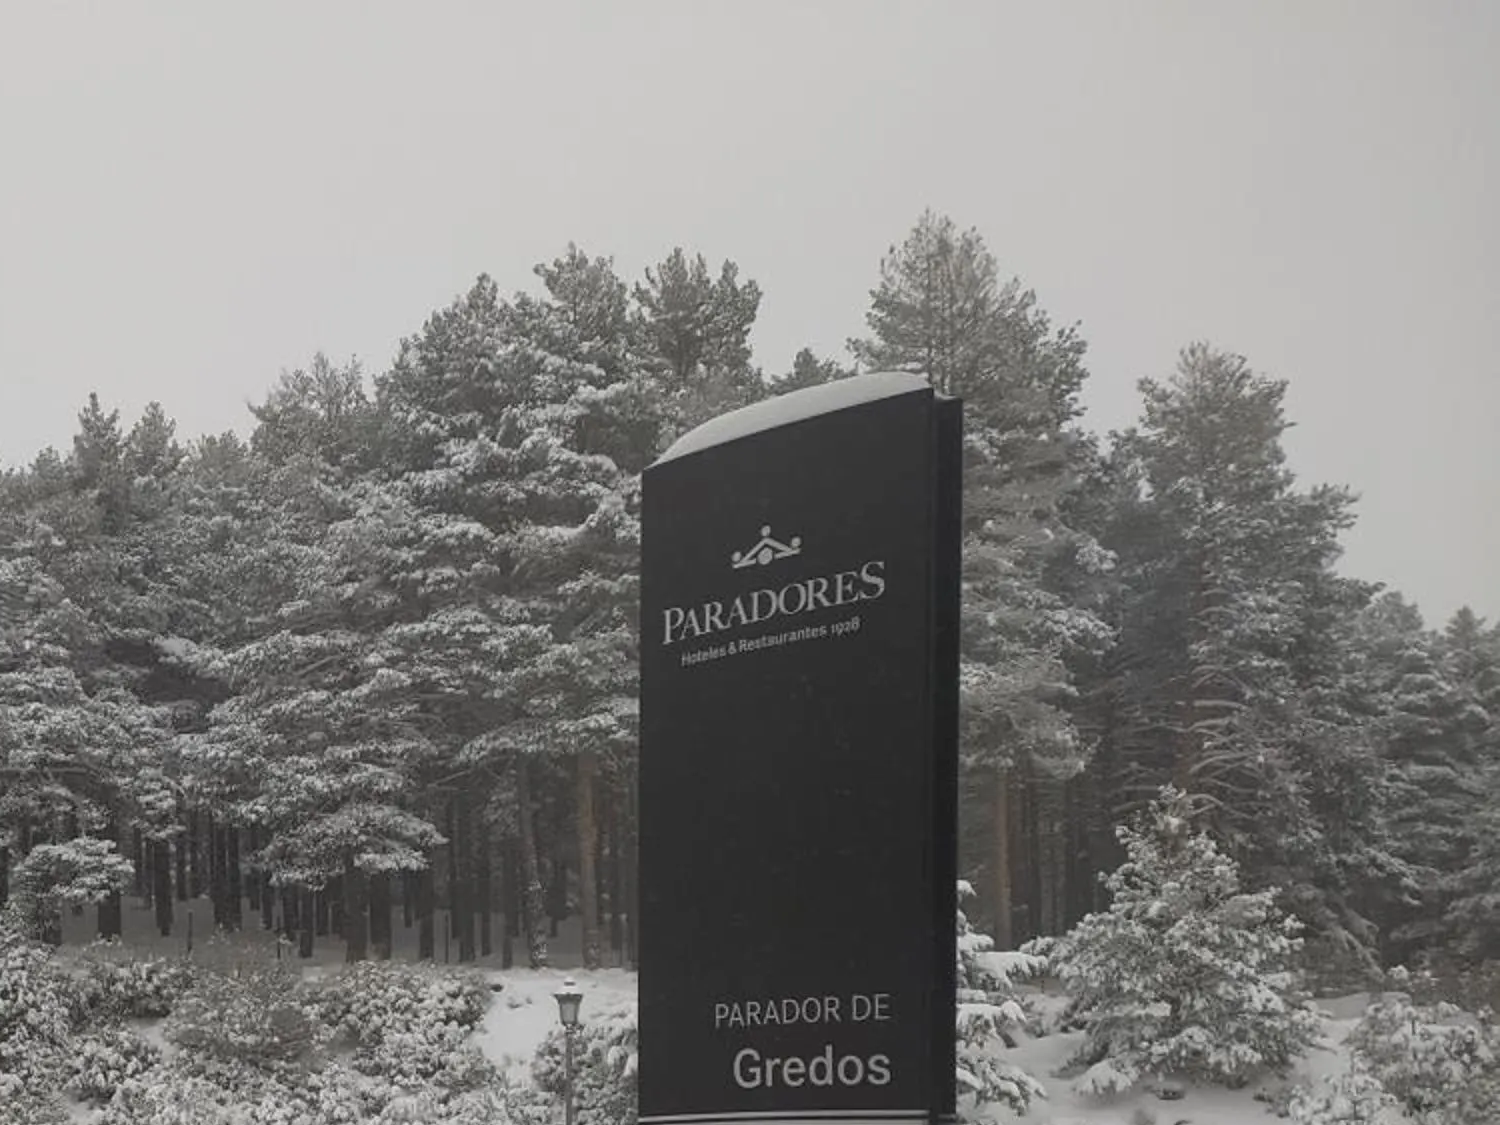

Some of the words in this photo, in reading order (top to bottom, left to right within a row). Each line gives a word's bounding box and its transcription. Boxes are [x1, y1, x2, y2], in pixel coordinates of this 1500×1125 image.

[662, 561, 885, 644] PARADORES
[681, 642, 727, 667] Hoteles
[728, 639, 737, 655] &
[739, 625, 827, 653] Restaurantes
[831, 615, 861, 637] 1928
[715, 996, 841, 1029] PARADOR
[852, 993, 891, 1021] DE
[733, 1044, 891, 1089] Gredos
